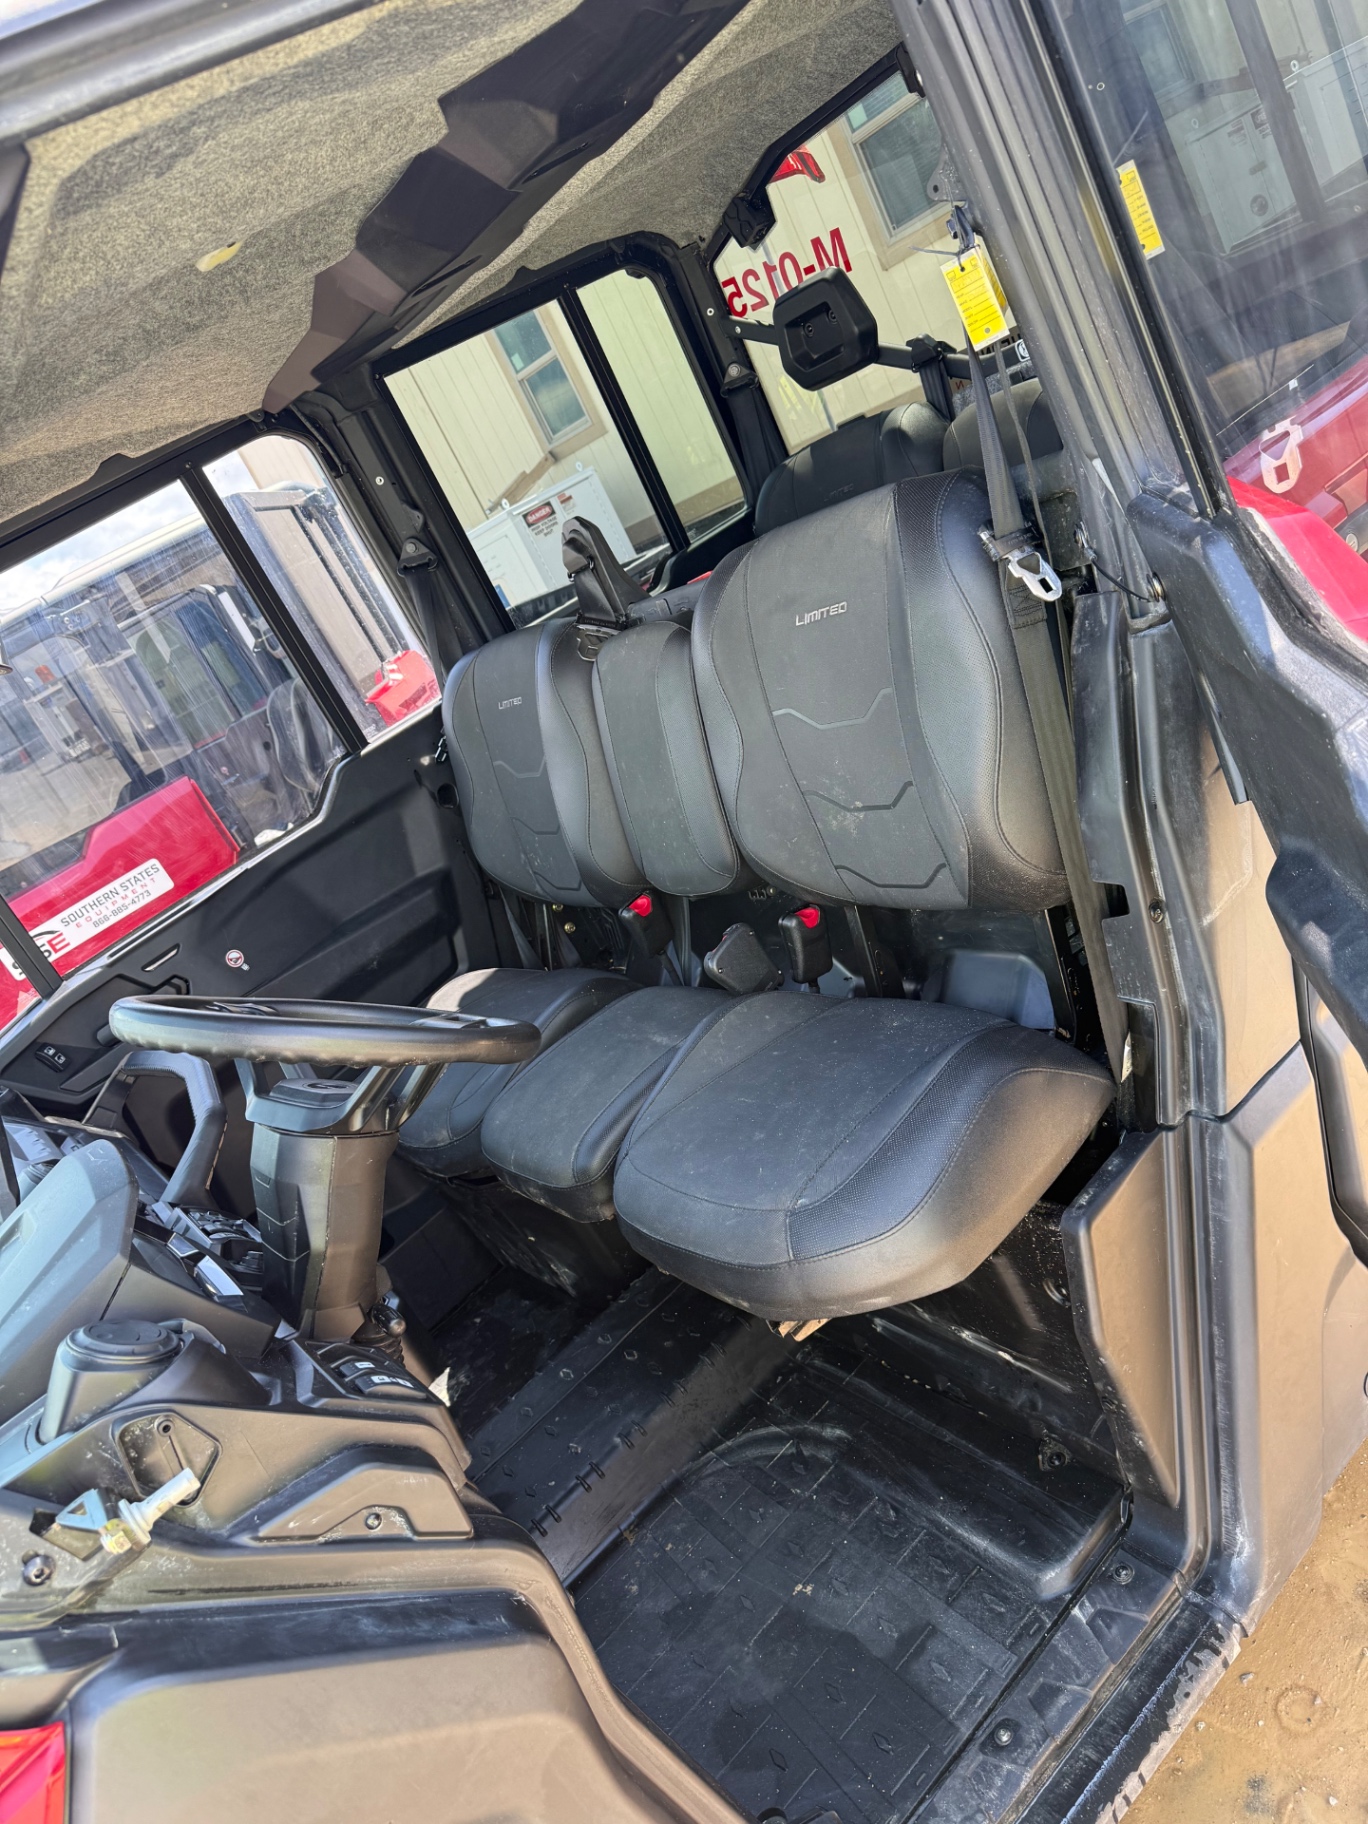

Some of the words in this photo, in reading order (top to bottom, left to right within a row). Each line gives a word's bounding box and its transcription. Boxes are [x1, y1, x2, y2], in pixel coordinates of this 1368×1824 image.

[795, 601, 848, 627] LIMITED
[498, 696, 523, 710] LIMITED
[60, 887, 120, 928] SOUTHERN
[119, 863, 161, 893] STATES
[75, 877, 157, 929] EQUIPMENT
